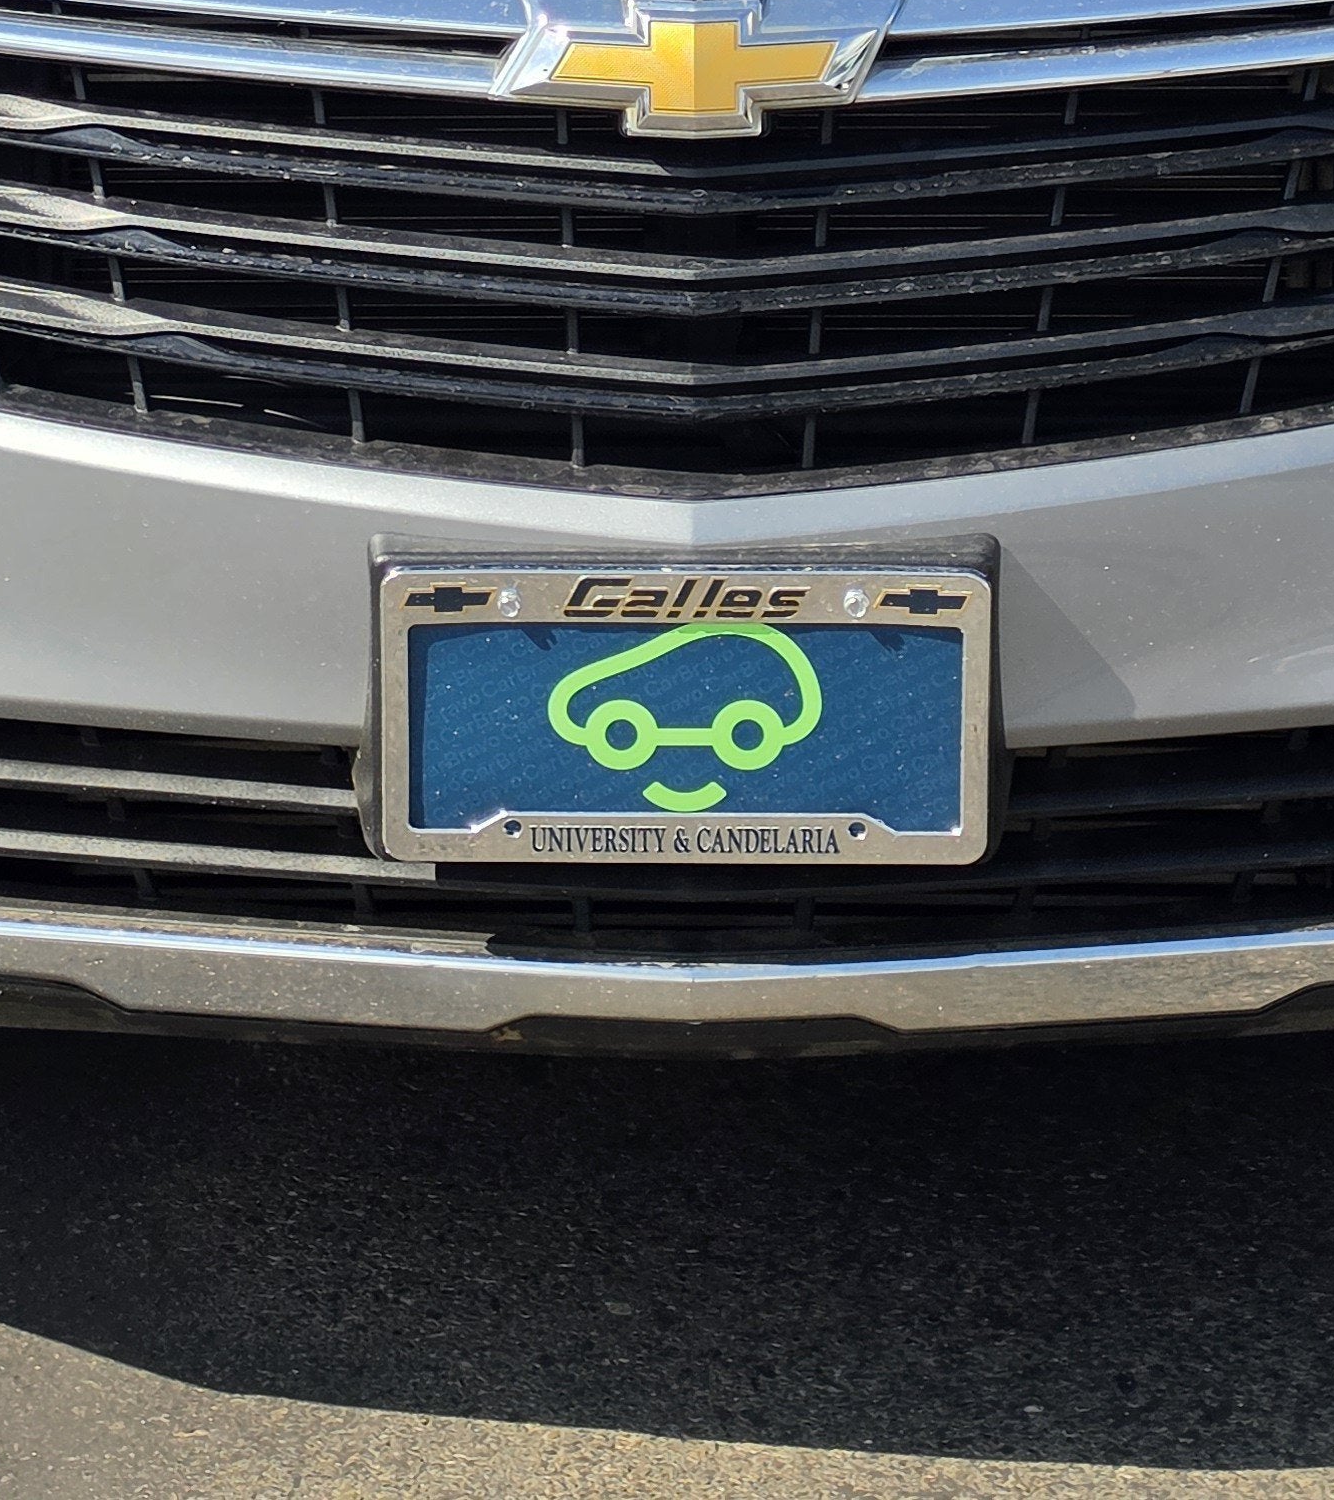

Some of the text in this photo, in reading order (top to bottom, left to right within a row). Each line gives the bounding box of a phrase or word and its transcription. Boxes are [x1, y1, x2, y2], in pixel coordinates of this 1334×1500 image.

[562, 576, 812, 618] Galles
[529, 826, 841, 855] UNIVERSITY & CANDELARIA
